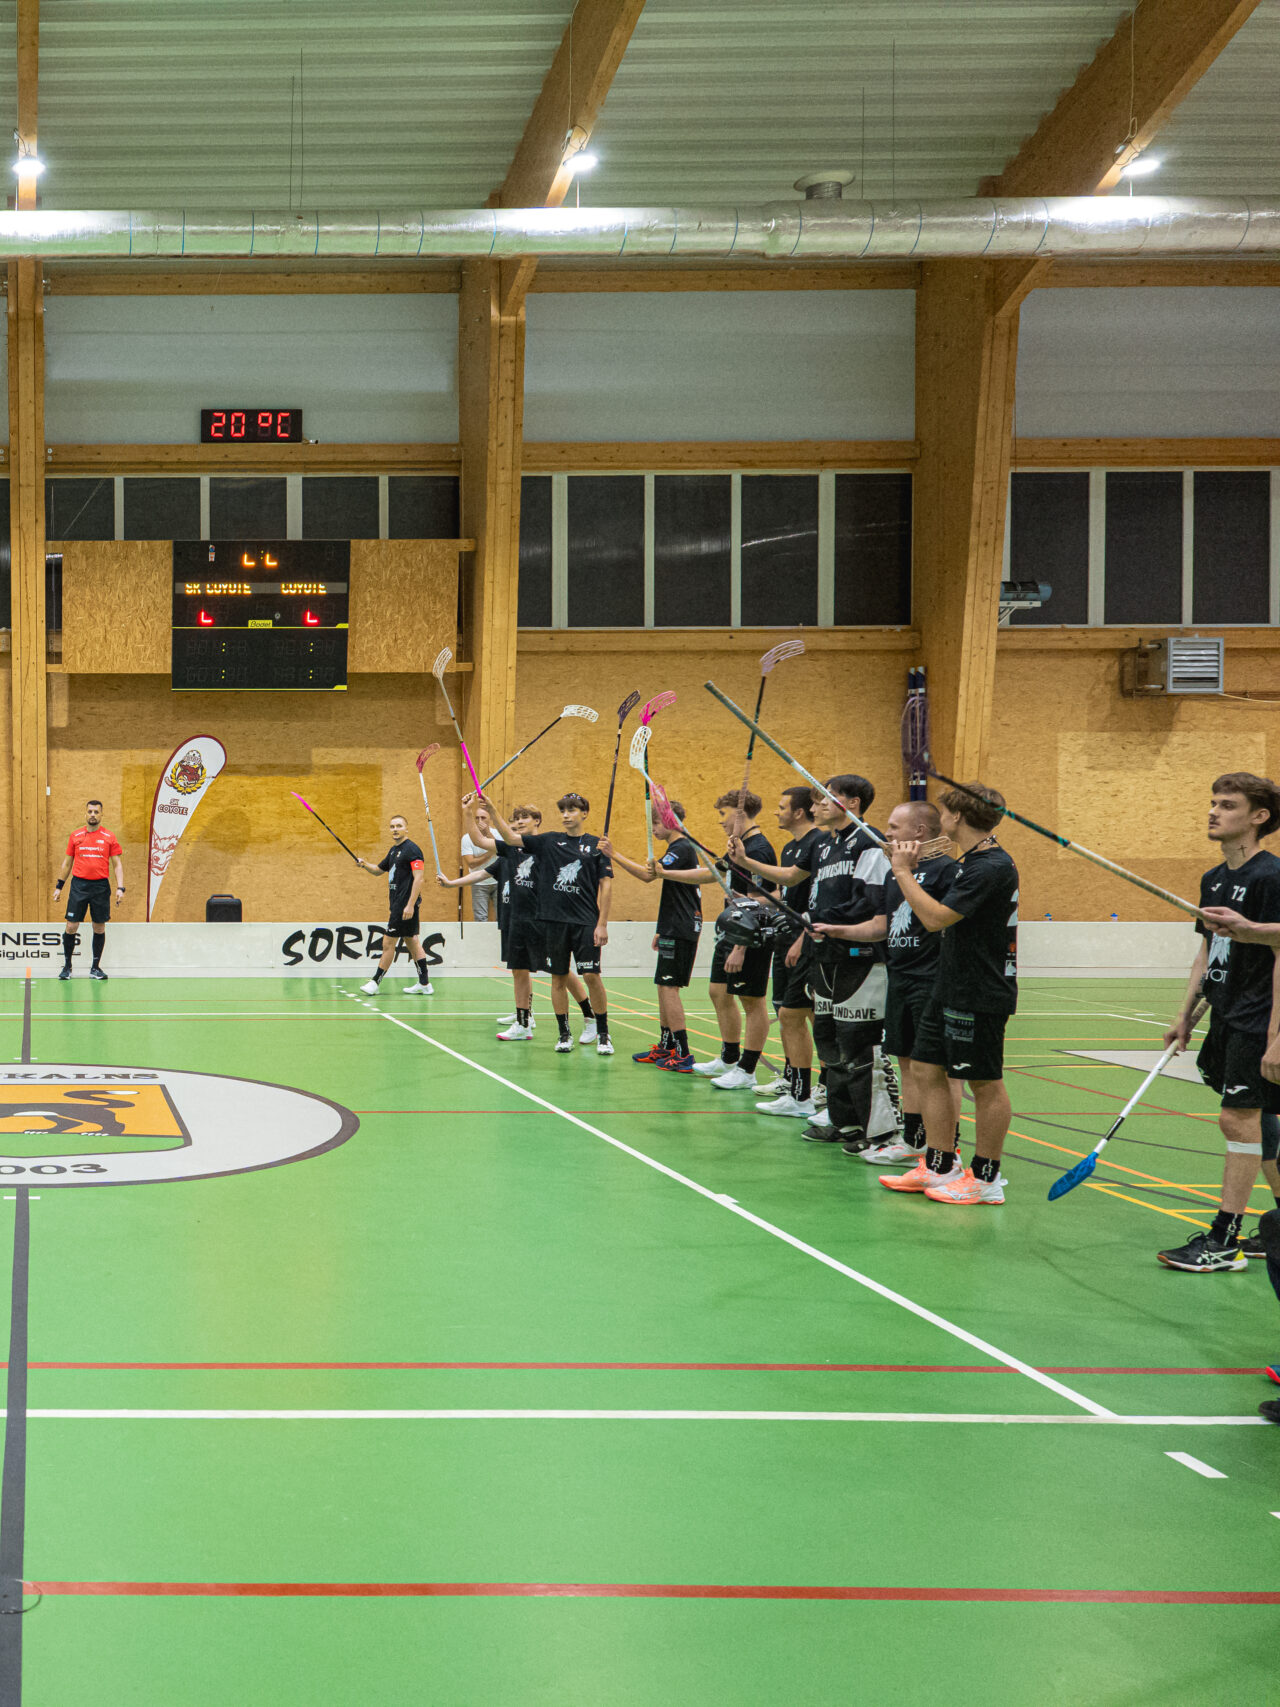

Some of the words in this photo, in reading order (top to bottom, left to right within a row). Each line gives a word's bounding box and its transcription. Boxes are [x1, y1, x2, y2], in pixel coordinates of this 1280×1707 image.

[211, 412, 246, 438] 20
[158, 804, 188, 815] COYOTE
[1231, 885, 1247, 901] 72
